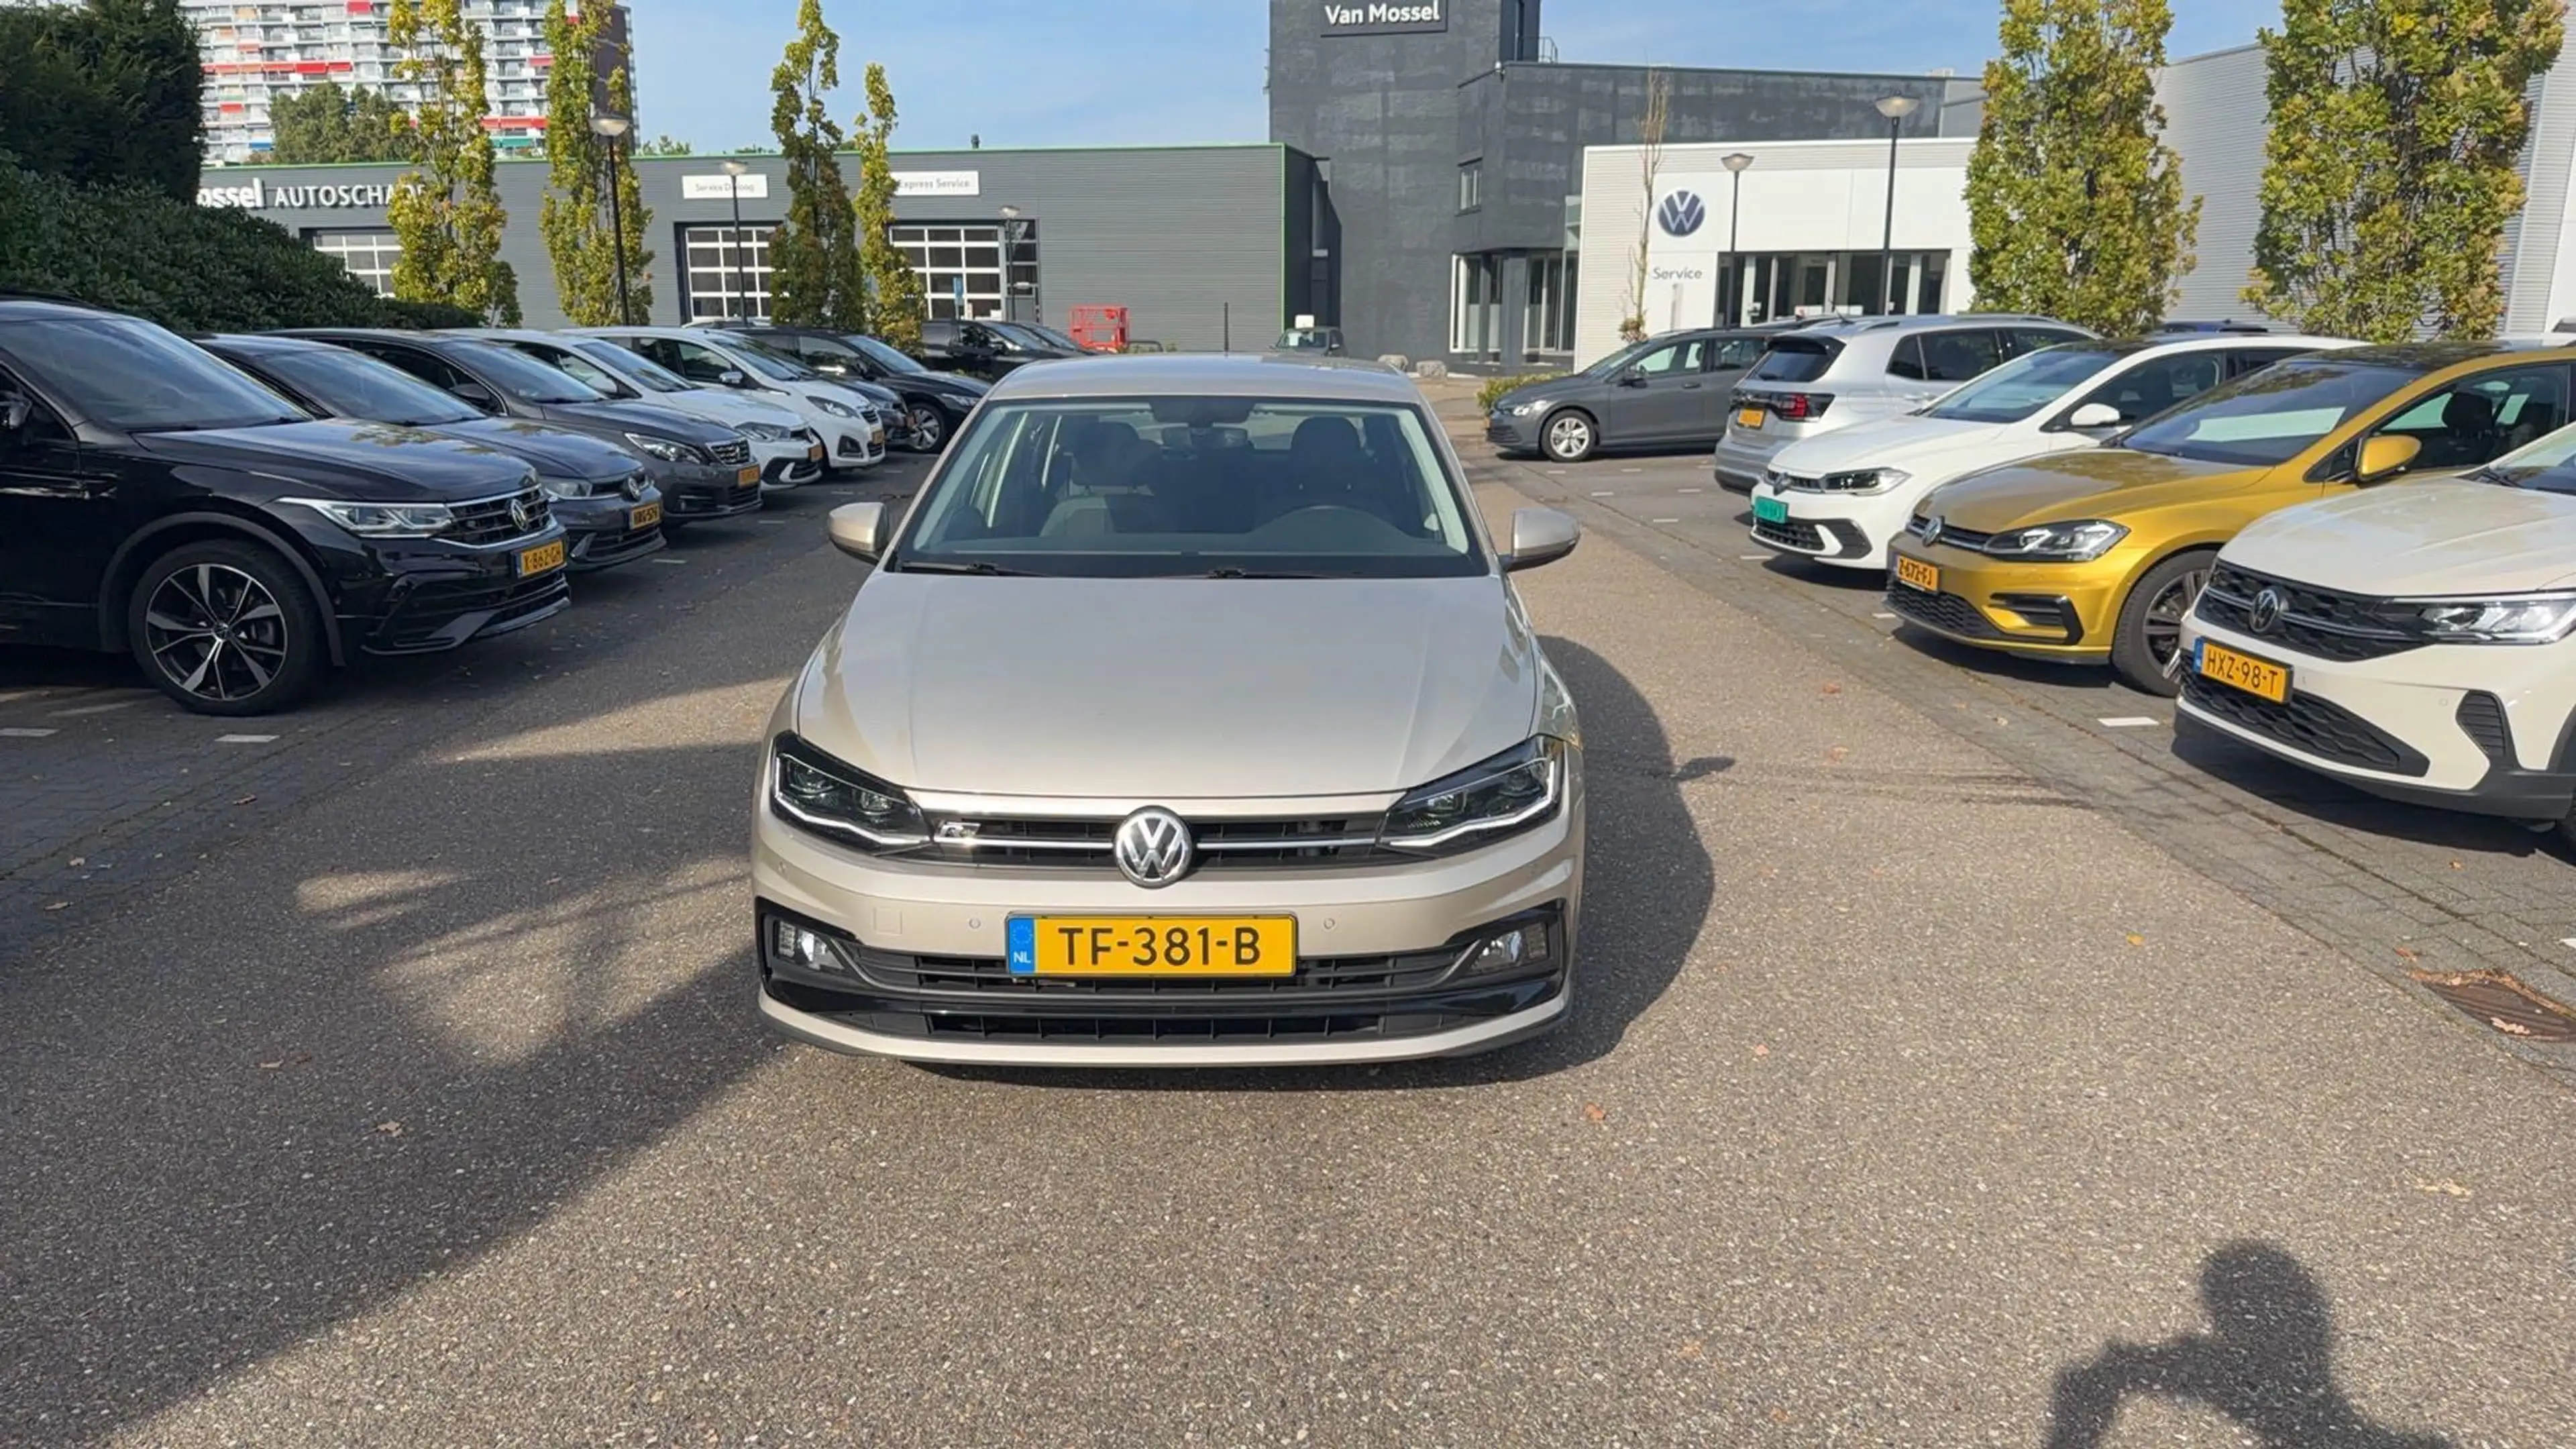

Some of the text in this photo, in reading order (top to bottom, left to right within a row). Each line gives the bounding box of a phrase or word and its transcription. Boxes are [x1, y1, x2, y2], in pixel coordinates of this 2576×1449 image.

[1324, 0, 1441, 25] Van Mossel
[196, 177, 263, 208] ossel
[936, 177, 970, 189] Service
[1653, 266, 1703, 280] Service
[2206, 649, 2278, 694] HXZ-98-T
[1014, 952, 1032, 963] NL
[1058, 926, 1261, 967] TF-381-B
